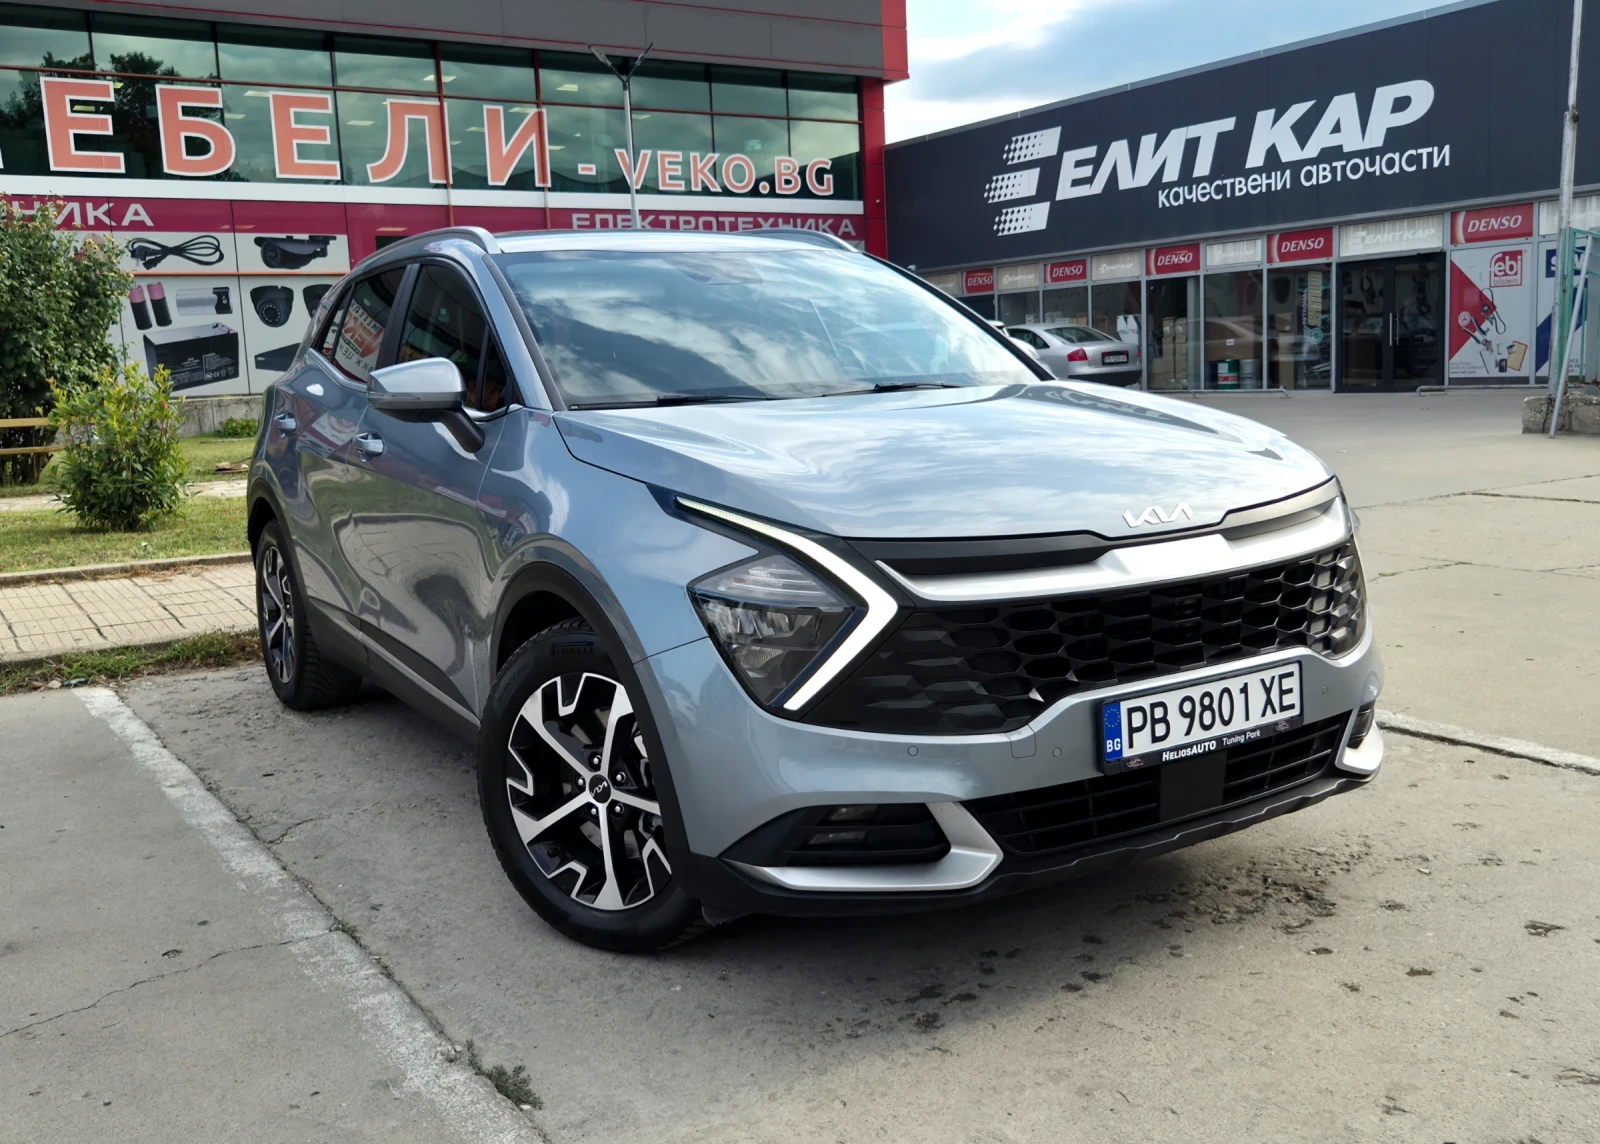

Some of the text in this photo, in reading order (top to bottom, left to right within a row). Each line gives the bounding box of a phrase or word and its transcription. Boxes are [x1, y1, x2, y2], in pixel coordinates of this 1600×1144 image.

[0, 76, 552, 187] ЕБЕЛИ
[614, 148, 835, 196] VEKO.BG
[1055, 79, 1435, 201] ЕЛИТ КАР
[1157, 143, 1451, 208] качествени авточасти
[1467, 214, 1523, 233] DENSO
[1280, 237, 1325, 253] DENSO
[1157, 252, 1193, 266] DENSO
[1489, 252, 1522, 277] febi
[1052, 264, 1083, 278] DENSO
[967, 275, 993, 287] DENSO
[1127, 670, 1296, 749] PB 9801 XE
[1106, 738, 1121, 753] BG
[1222, 734, 1245, 746] Tuning
[1246, 729, 1261, 740] Park
